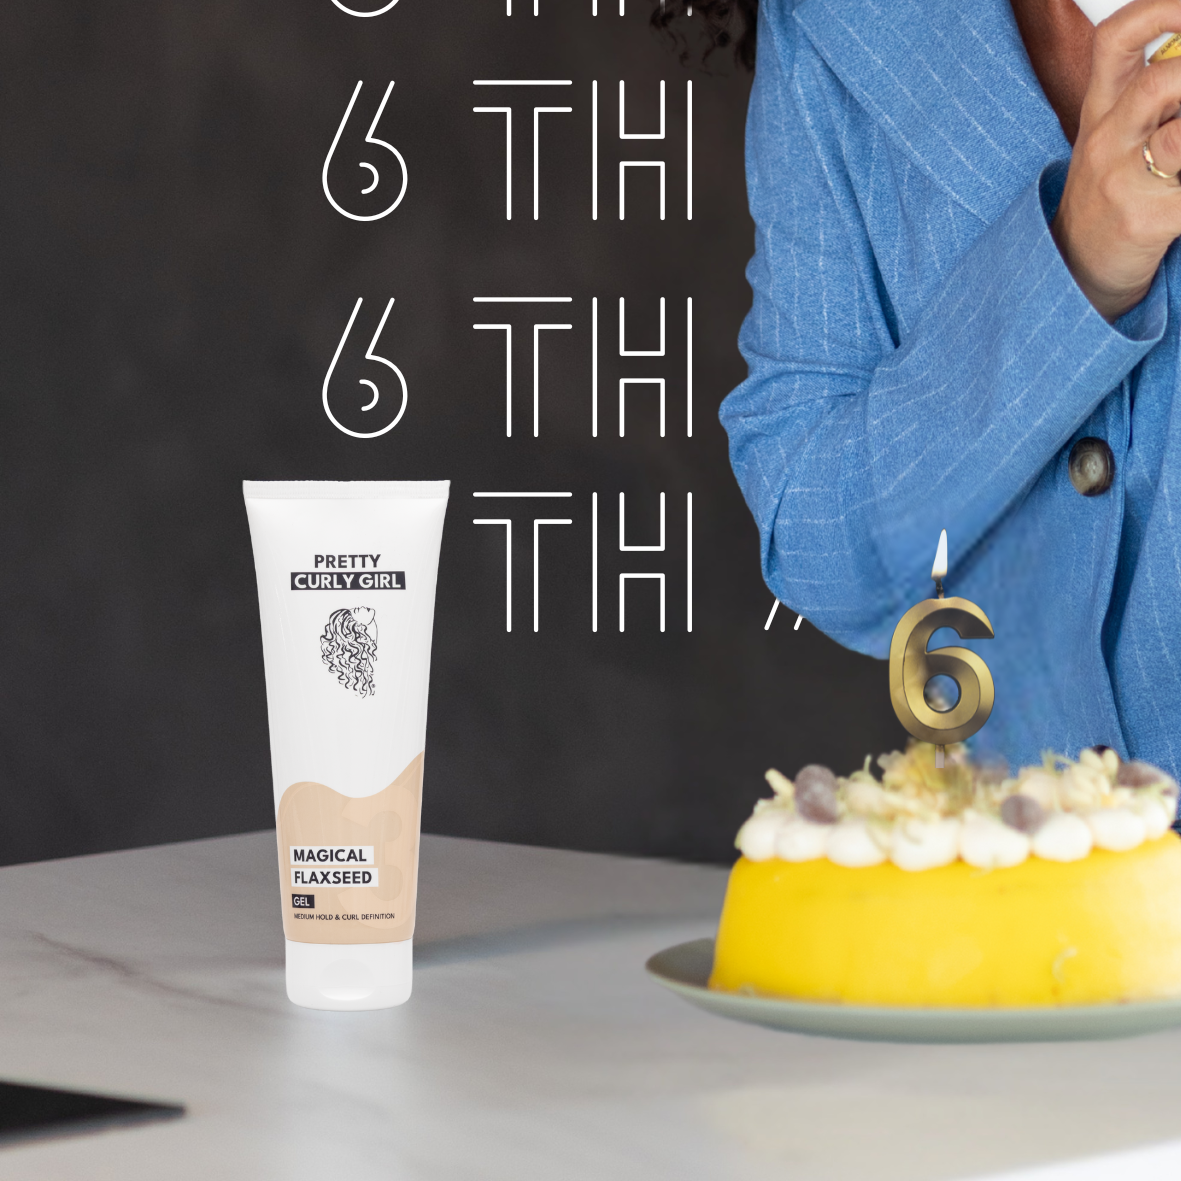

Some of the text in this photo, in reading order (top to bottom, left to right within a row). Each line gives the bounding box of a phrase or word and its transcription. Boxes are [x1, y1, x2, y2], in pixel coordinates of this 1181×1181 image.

[314, 554, 381, 569] PRETTY
[294, 573, 402, 589] CURLY GIRL
[889, 596, 995, 746] 6
[293, 848, 367, 863] MAGICAL
[294, 870, 373, 885] FLAXSEED
[293, 896, 311, 907] GEL
[315, 913, 334, 921] HOLD
[361, 912, 396, 921] DEFINITION
